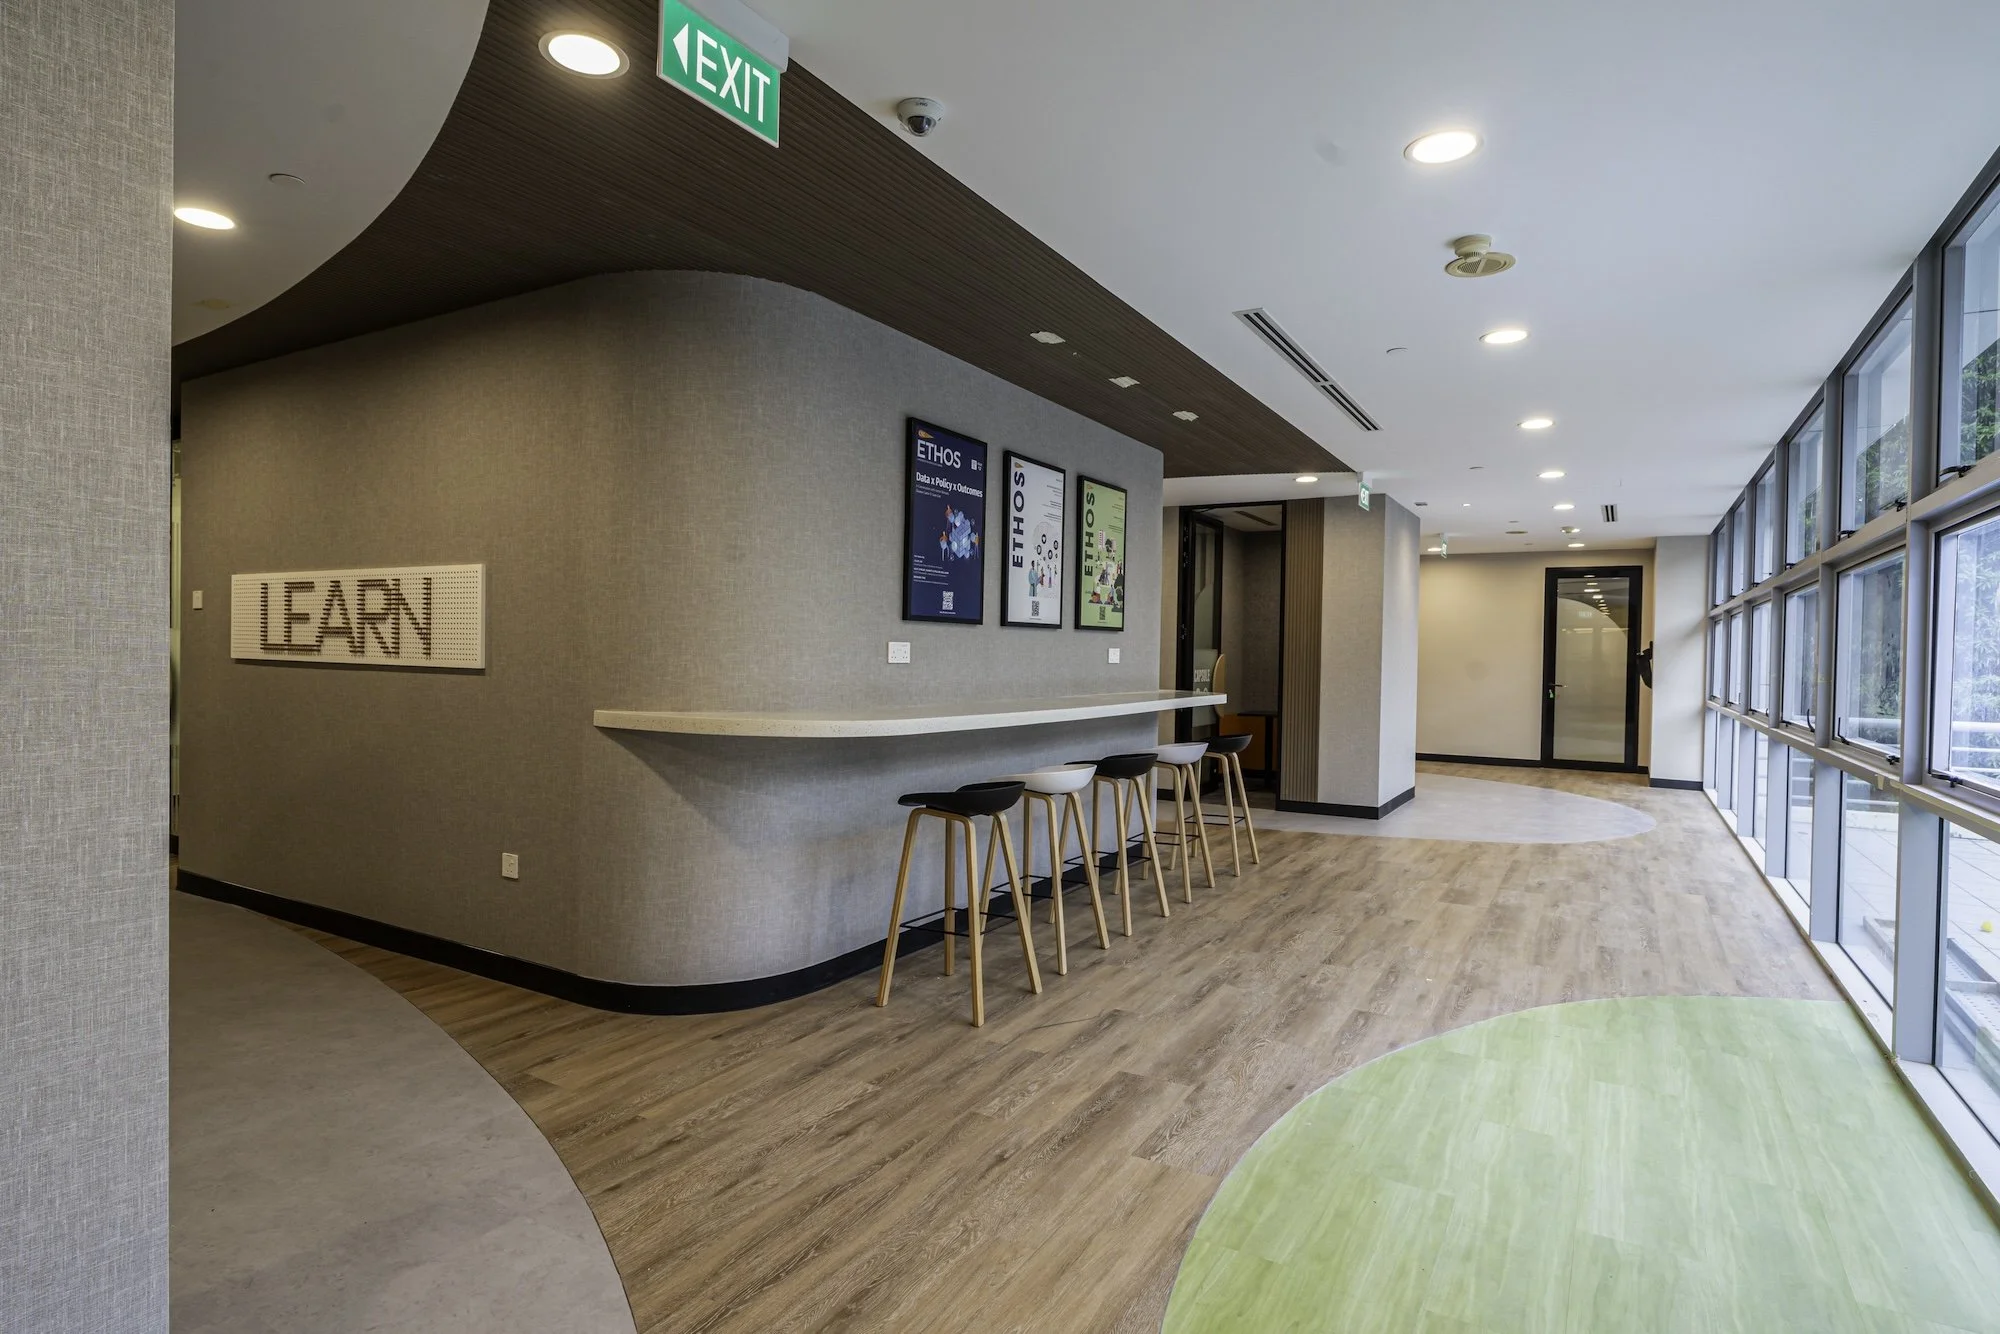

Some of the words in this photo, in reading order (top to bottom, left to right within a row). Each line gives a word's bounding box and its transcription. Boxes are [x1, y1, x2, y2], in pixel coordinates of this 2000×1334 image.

[696, 30, 771, 123] EXIT
[916, 471, 930, 484] Data
[931, 477, 935, 485] x
[935, 477, 953, 492] Policy
[957, 483, 983, 498] Outcomes
[917, 439, 961, 469] ETHOS
[1012, 471, 1025, 568] ETHOS
[1084, 491, 1095, 576] ETHOS
[260, 577, 432, 659] LEARN
